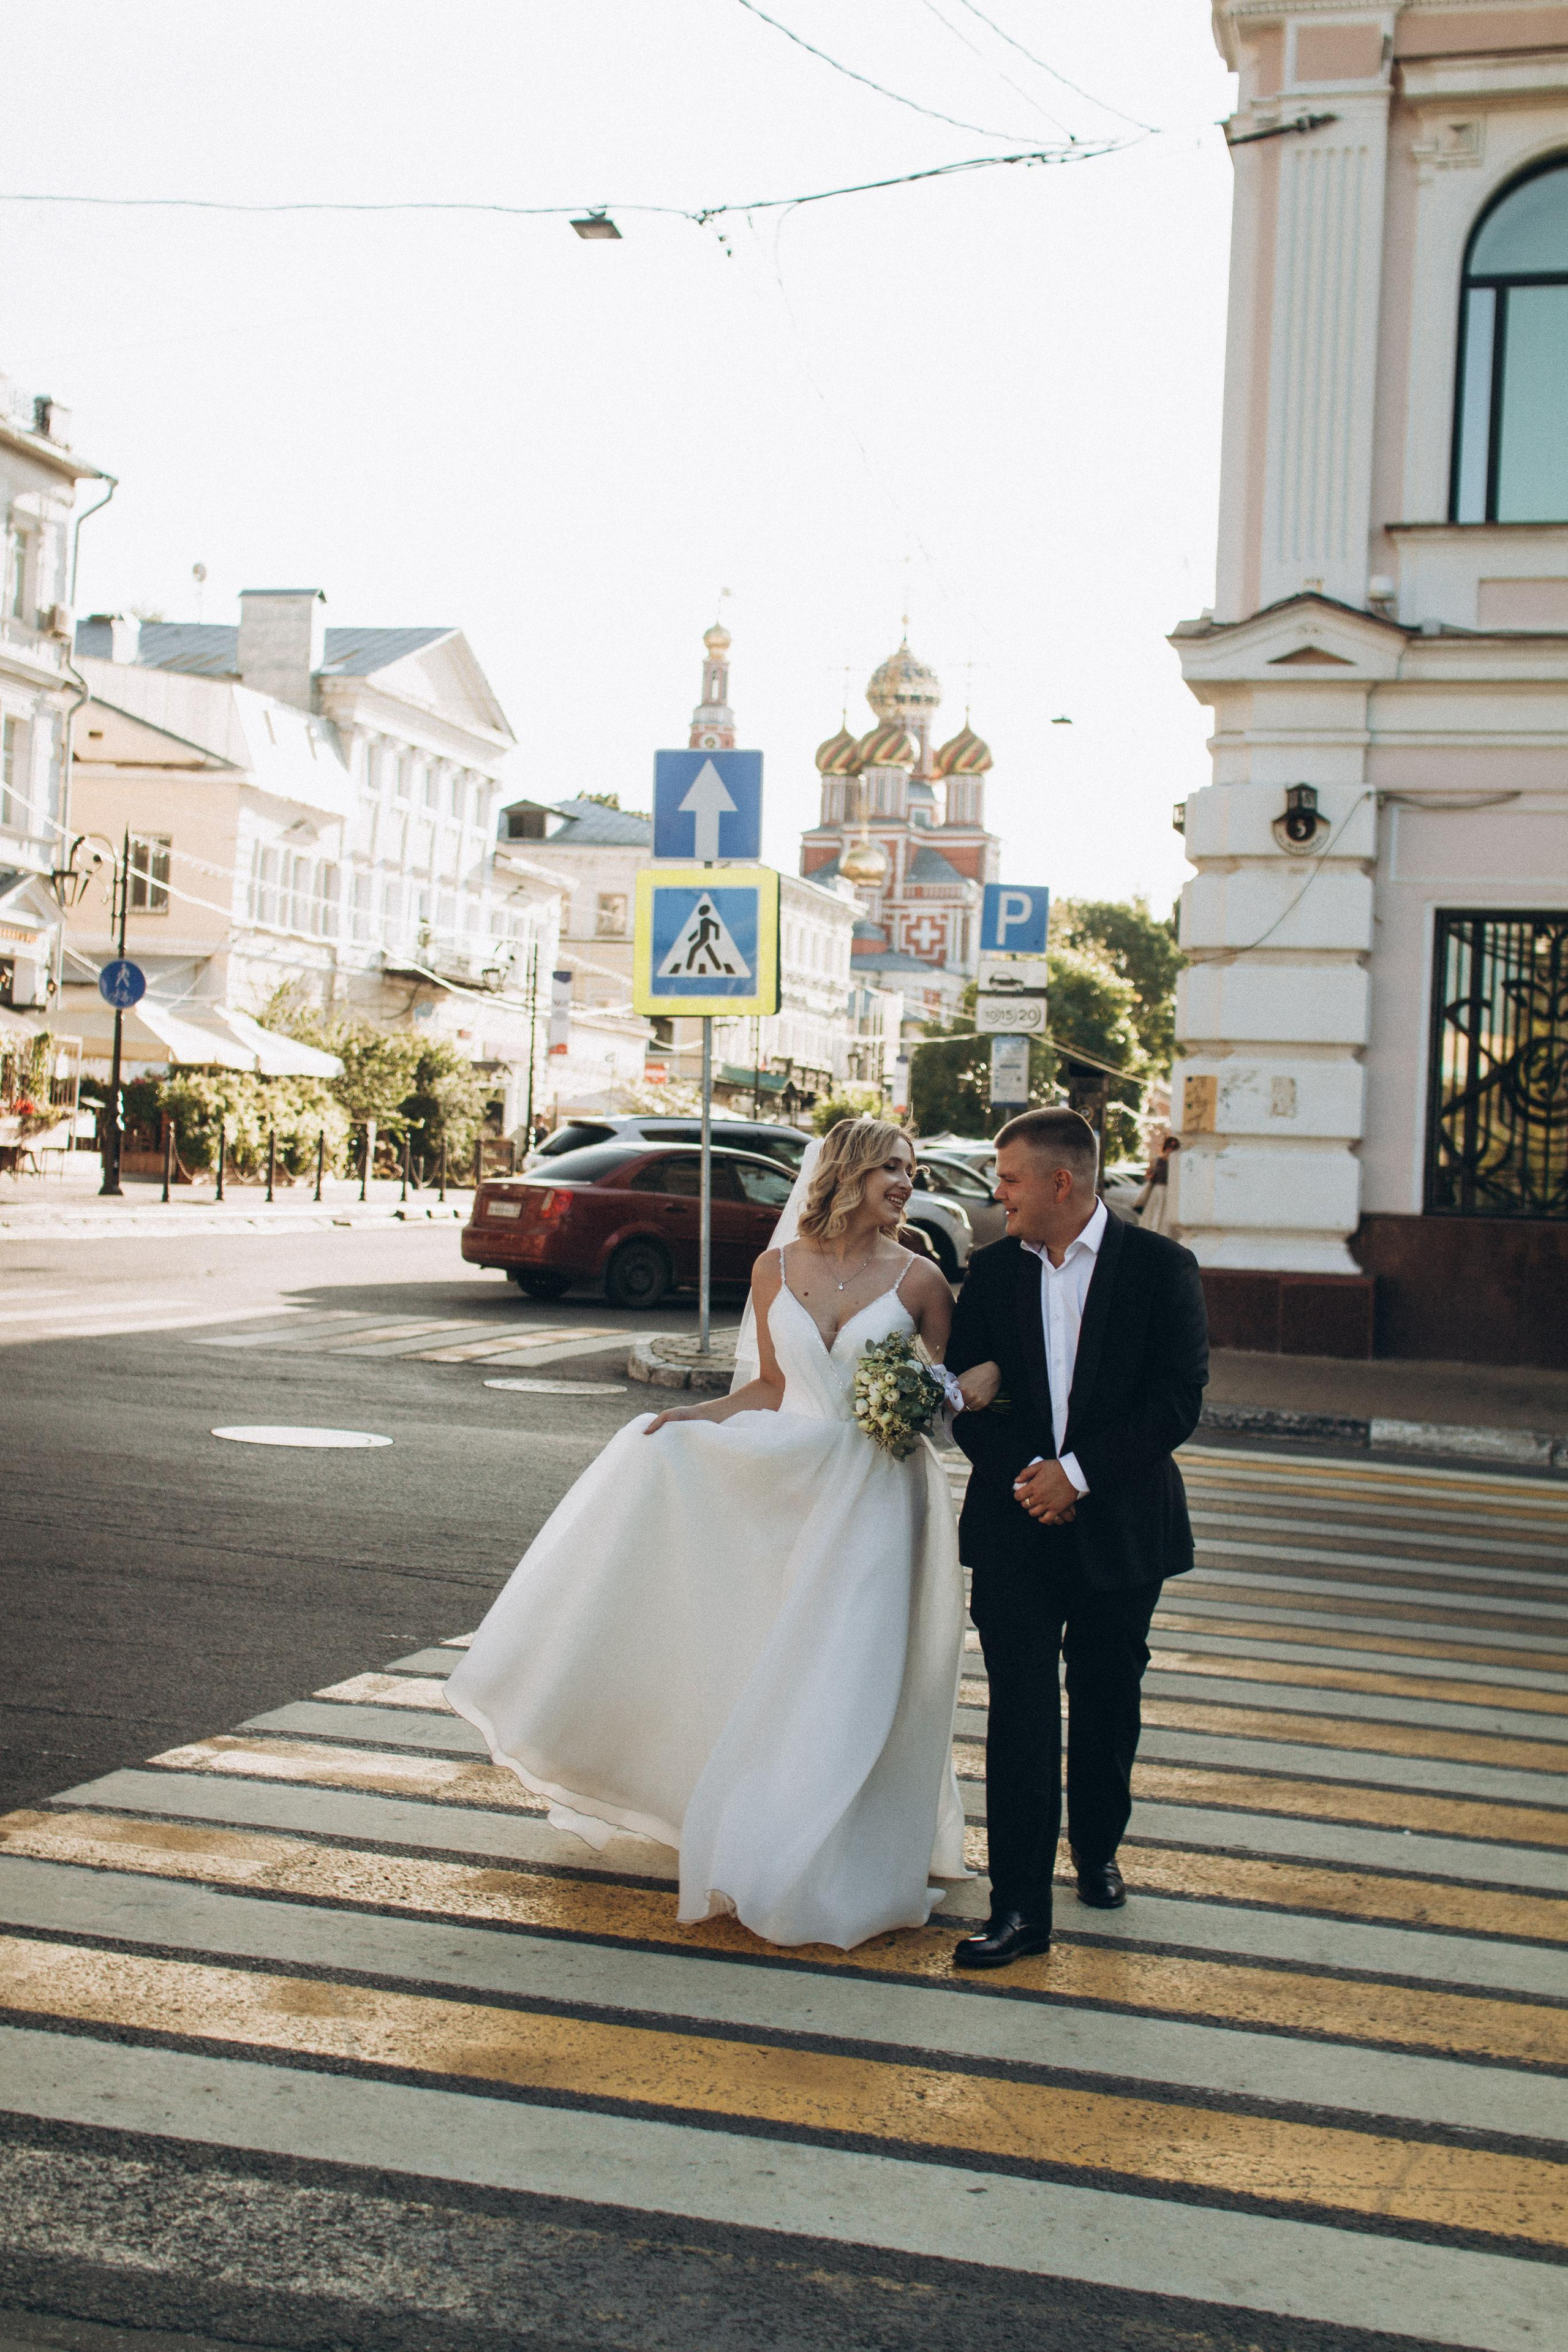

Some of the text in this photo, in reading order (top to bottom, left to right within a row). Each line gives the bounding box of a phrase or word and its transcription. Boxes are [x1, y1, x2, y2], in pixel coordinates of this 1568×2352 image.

[996, 891, 1033, 946] P
[1000, 1009, 1013, 1020] 15
[1018, 1009, 1037, 1021] 20
